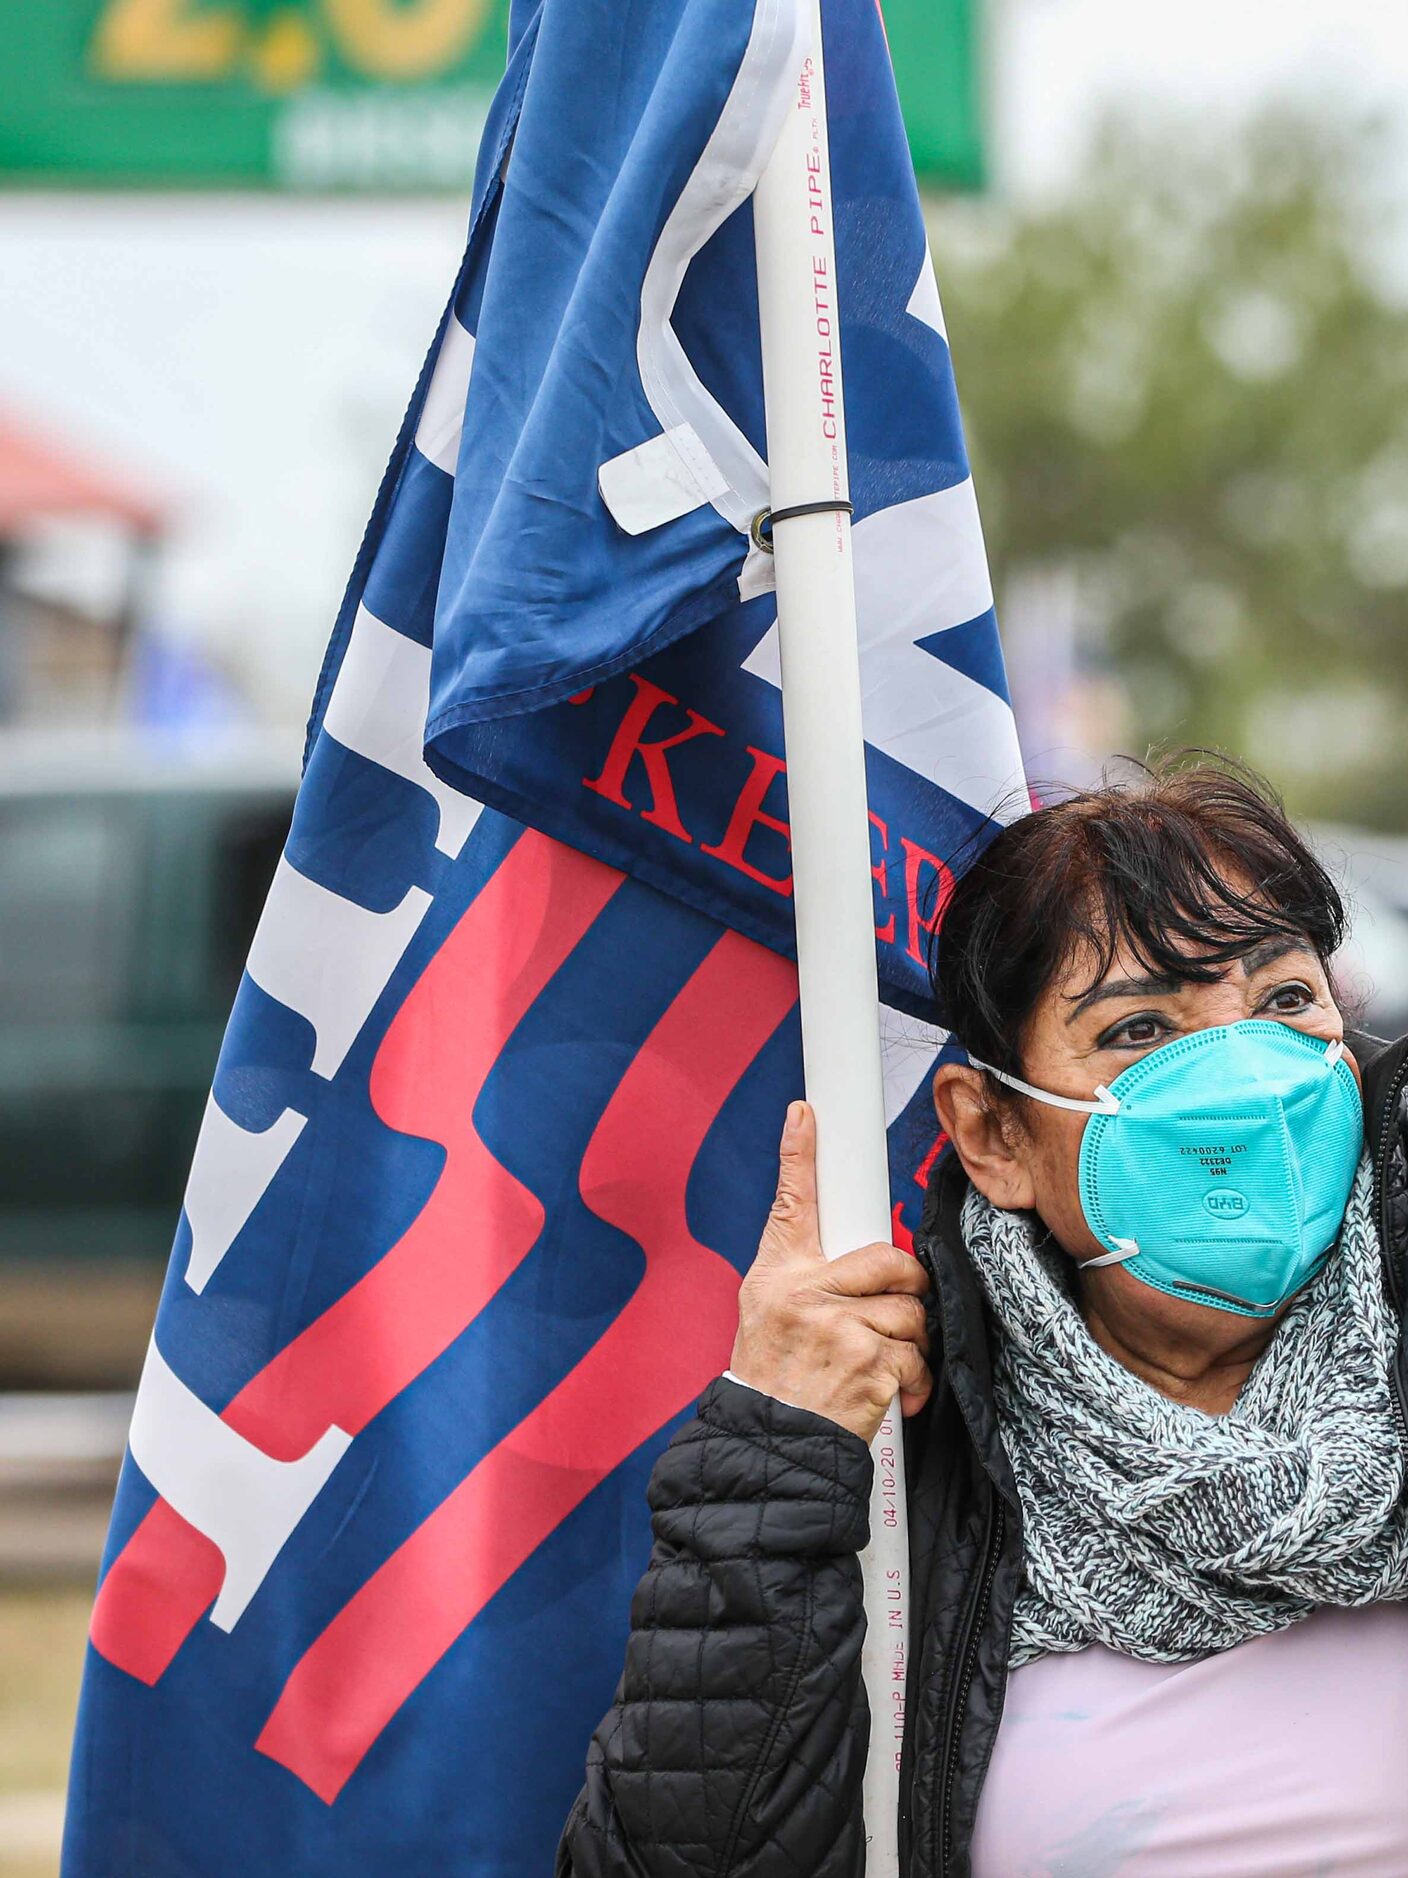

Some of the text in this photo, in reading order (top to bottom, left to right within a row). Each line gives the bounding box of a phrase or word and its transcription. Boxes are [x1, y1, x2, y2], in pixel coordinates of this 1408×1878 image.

[813, 255, 836, 440] CHARLOTTE
[583, 673, 957, 968] KEP
[1231, 1144, 1247, 1153] LOT
[1210, 1167, 1227, 1175] N95
[1208, 1197, 1244, 1210] BYD
[879, 1446, 897, 1527] 04/10/20
[888, 1610, 902, 1628] IN
